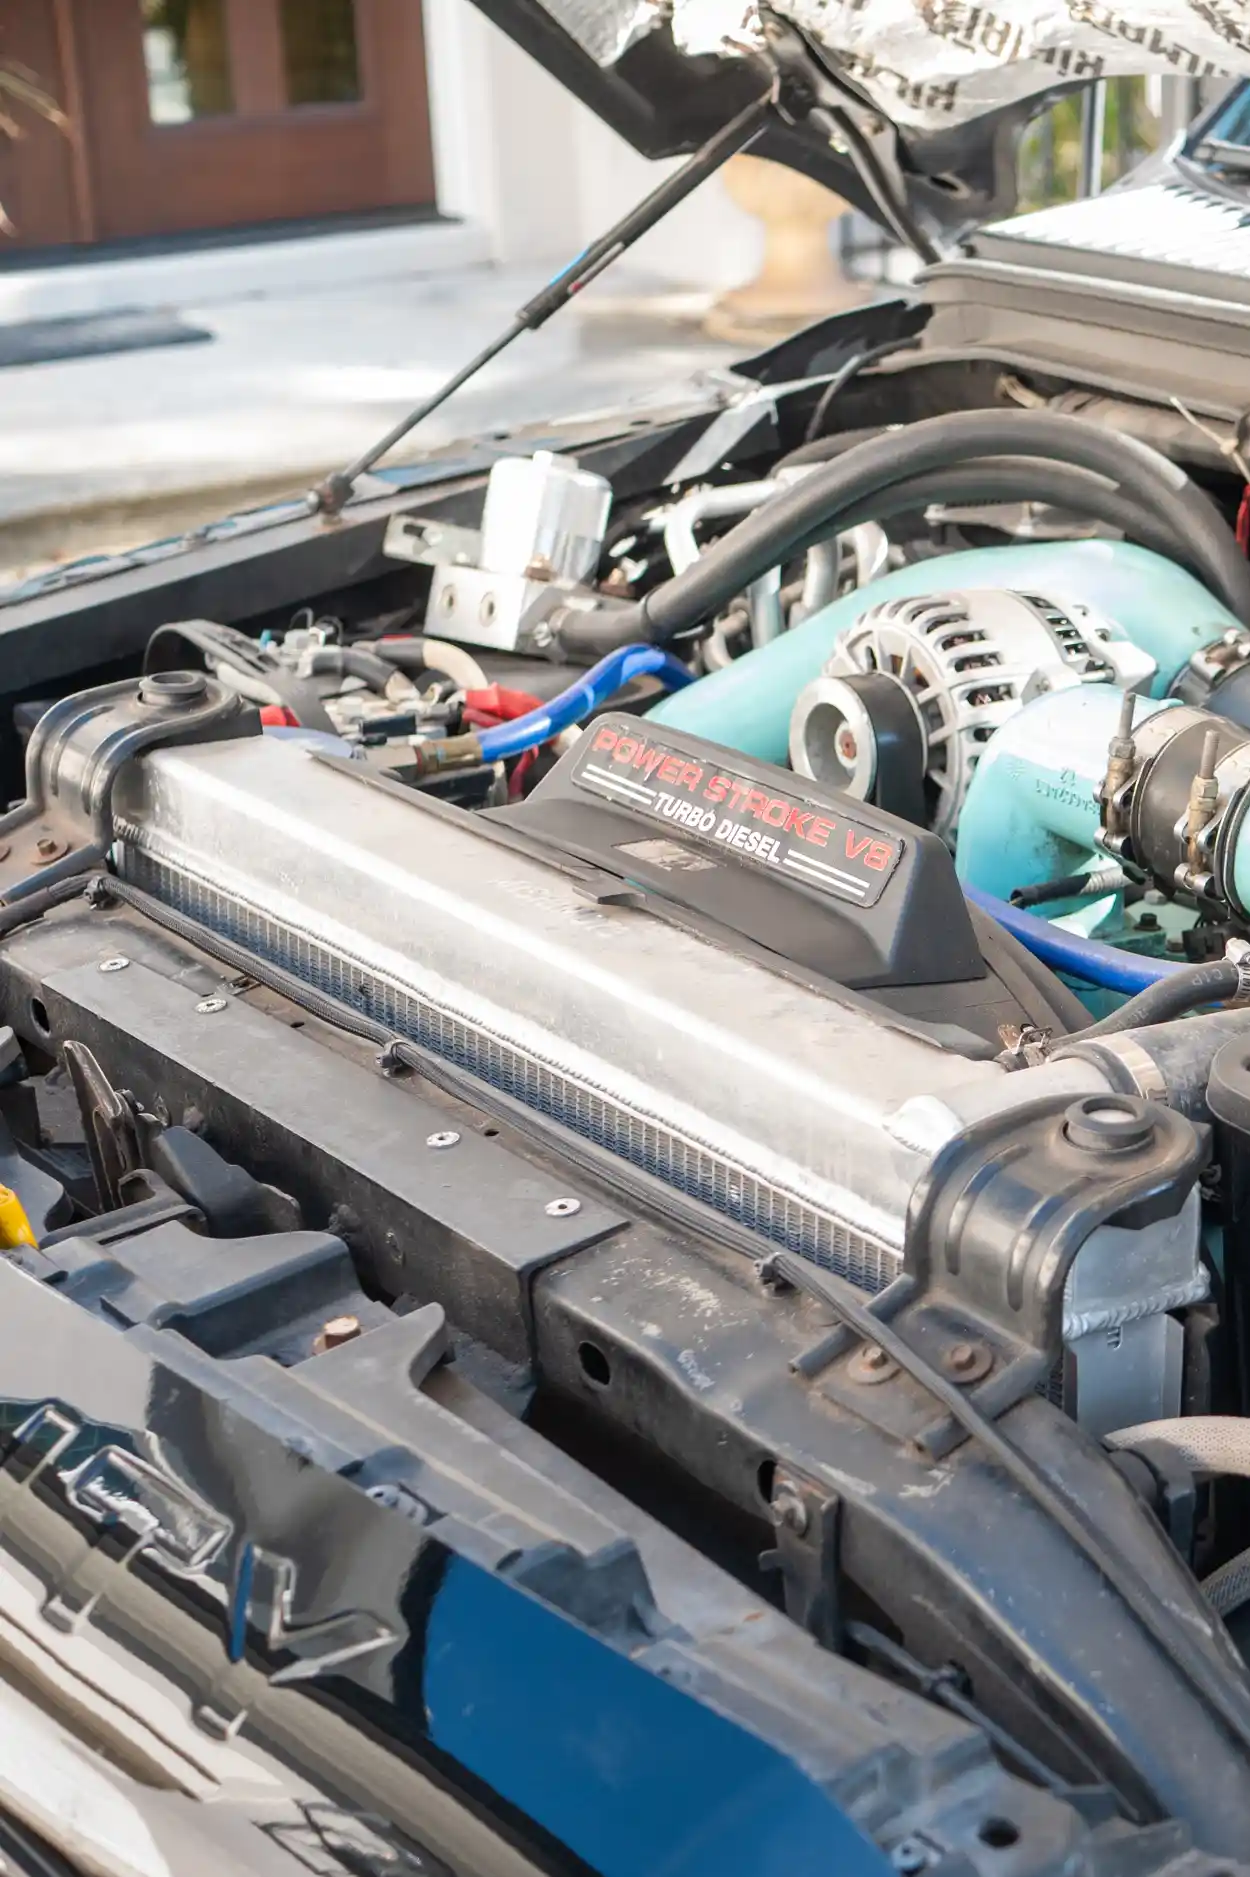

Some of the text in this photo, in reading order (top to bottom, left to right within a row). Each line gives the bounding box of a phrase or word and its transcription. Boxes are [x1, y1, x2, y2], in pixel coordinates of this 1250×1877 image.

[592, 727, 894, 873] POWER STROKE V8
[653, 790, 783, 865] TURBO DIESEL
